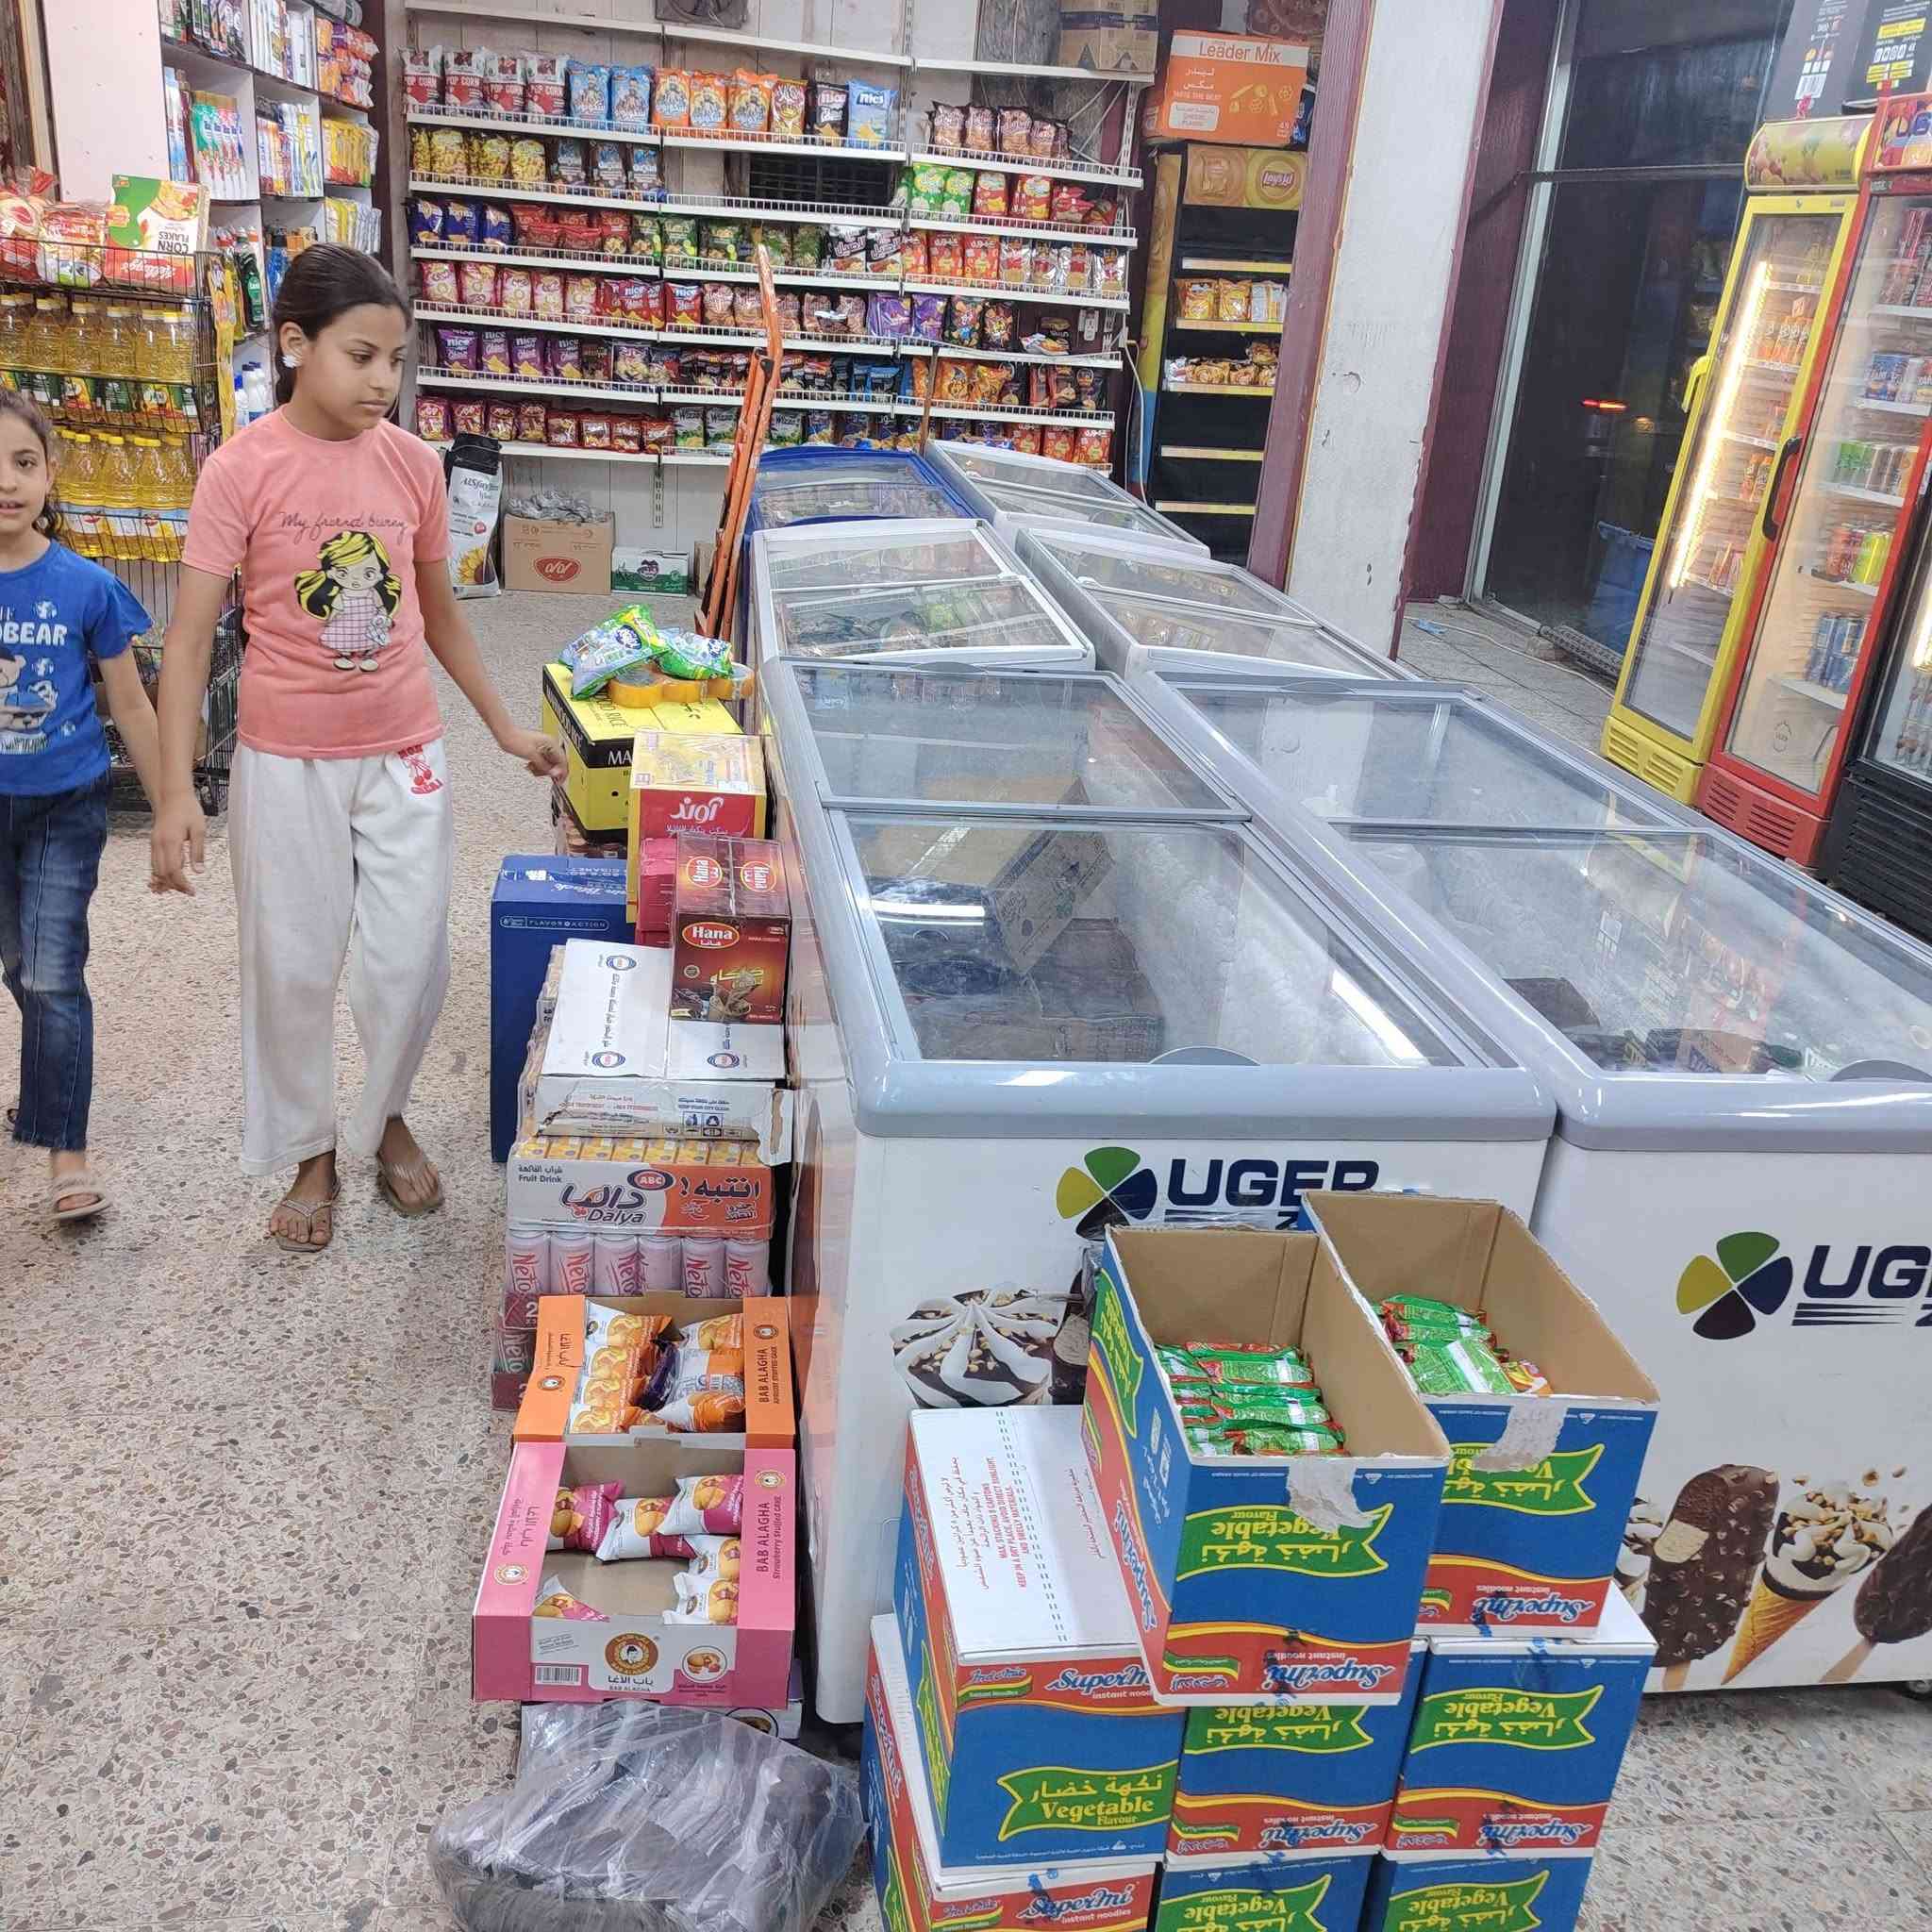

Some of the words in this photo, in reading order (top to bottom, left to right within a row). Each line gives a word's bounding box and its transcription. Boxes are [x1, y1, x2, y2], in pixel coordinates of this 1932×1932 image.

[1199, 41, 1250, 60] Leader
[1255, 43, 1282, 63] Mix
[419, 76, 437, 86] CORN
[459, 76, 480, 86] CORN
[158, 231, 191, 240] FLAKES
[158, 240, 189, 255] CORN
[0, 622, 67, 646] BEAR
[692, 926, 733, 940] Hana
[519, 1174, 537, 1183] Fruit
[539, 1174, 561, 1184] Drink
[640, 1175, 662, 1185] ABC
[1803, 1245, 1932, 1299] UG
[756, 1348, 769, 1383] ALAGHA
[757, 1385, 769, 1403] BAB
[981, 1482, 995, 1508] CARTONS
[993, 1486, 1008, 1506] DIRECT
[1491, 1478, 1566, 1502] خضار
[756, 1502, 771, 1547] ALAGHA
[999, 1507, 1012, 1524] AVOID
[1231, 1510, 1278, 1522] Flavour
[991, 1514, 1005, 1542] STACKING
[1008, 1545, 1020, 1557] DRY
[1021, 1542, 1030, 1554] AND
[1201, 1541, 1268, 1565] نكهة
[1274, 1538, 1354, 1564] خضار
[756, 1549, 770, 1573] BAB
[1016, 1572, 1026, 1588] KEEP
[1514, 1585, 1551, 1595] instant
[1092, 1690, 1128, 1699] instant
[1130, 1690, 1153, 1698] nood
[1214, 1706, 1332, 1724] Vegetable
[1442, 1696, 1557, 1718] Vegetable
[1207, 1724, 1267, 1744] نكهة
[1274, 1721, 1341, 1742] خضار
[1433, 1718, 1492, 1739] نكهة
[1498, 1717, 1566, 1739] خضار
[1030, 1780, 1098, 1803] خضار
[1105, 1774, 1163, 1796] نكهة
[1041, 1798, 1155, 1823] Vegetable
[1300, 1813, 1335, 1823] instant
[1097, 1816, 1138, 1826] Flavour
[1201, 1893, 1239, 1905] Flavour
[1408, 1890, 1510, 1917] Vegetable
[1061, 1913, 1095, 1924] instant
[1096, 1909, 1131, 1920] noodles
[1183, 1897, 1288, 1924] Vegetable
[1456, 1907, 1516, 1931] خضار
